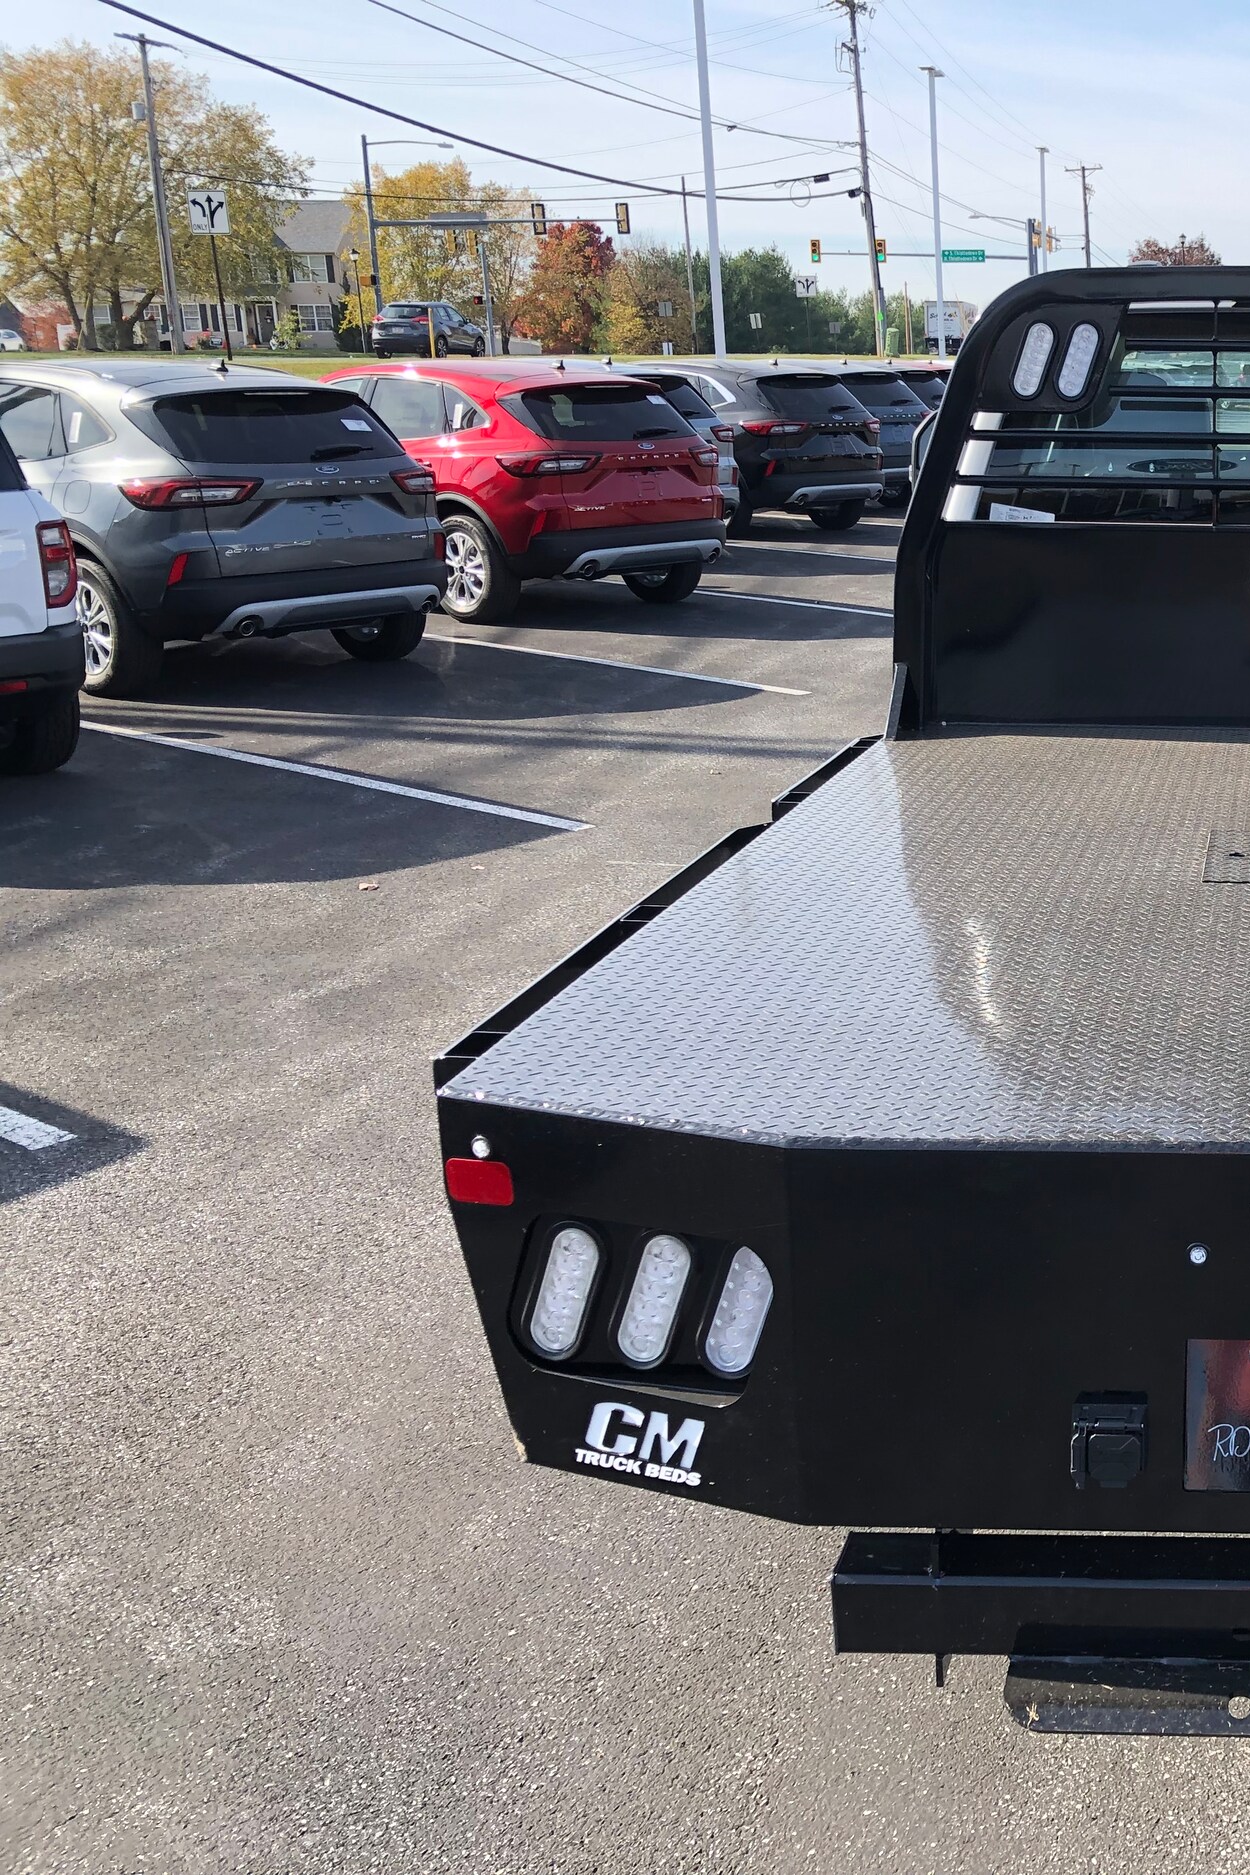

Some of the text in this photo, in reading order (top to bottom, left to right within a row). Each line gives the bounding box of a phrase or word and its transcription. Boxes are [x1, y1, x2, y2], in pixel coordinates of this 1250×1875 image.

[193, 223, 208, 231] ONLY
[584, 1402, 706, 1472] CM
[574, 1448, 702, 1487] TRUCK BEDS
